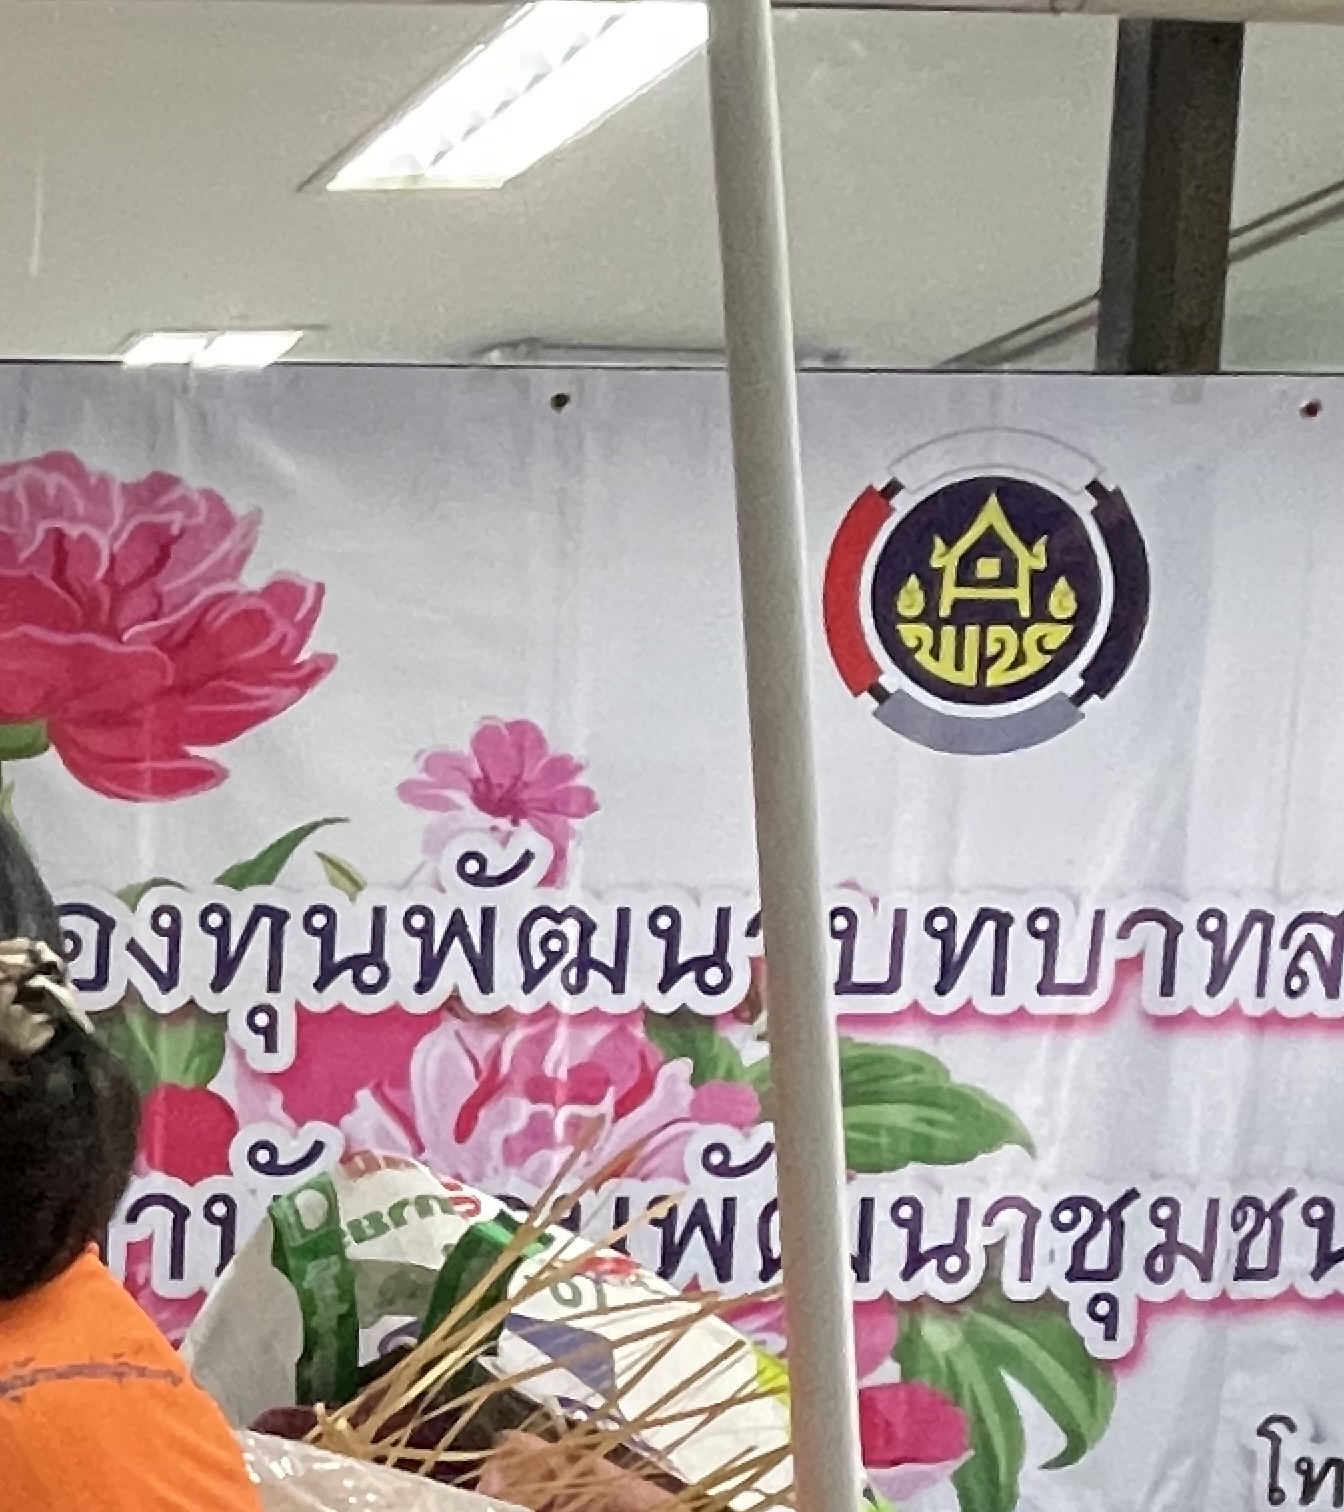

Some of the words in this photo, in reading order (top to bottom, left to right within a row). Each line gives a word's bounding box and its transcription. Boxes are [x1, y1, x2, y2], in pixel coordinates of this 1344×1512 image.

[58, 848, 1344, 1054] องทุนพัฒนบทบาทส
